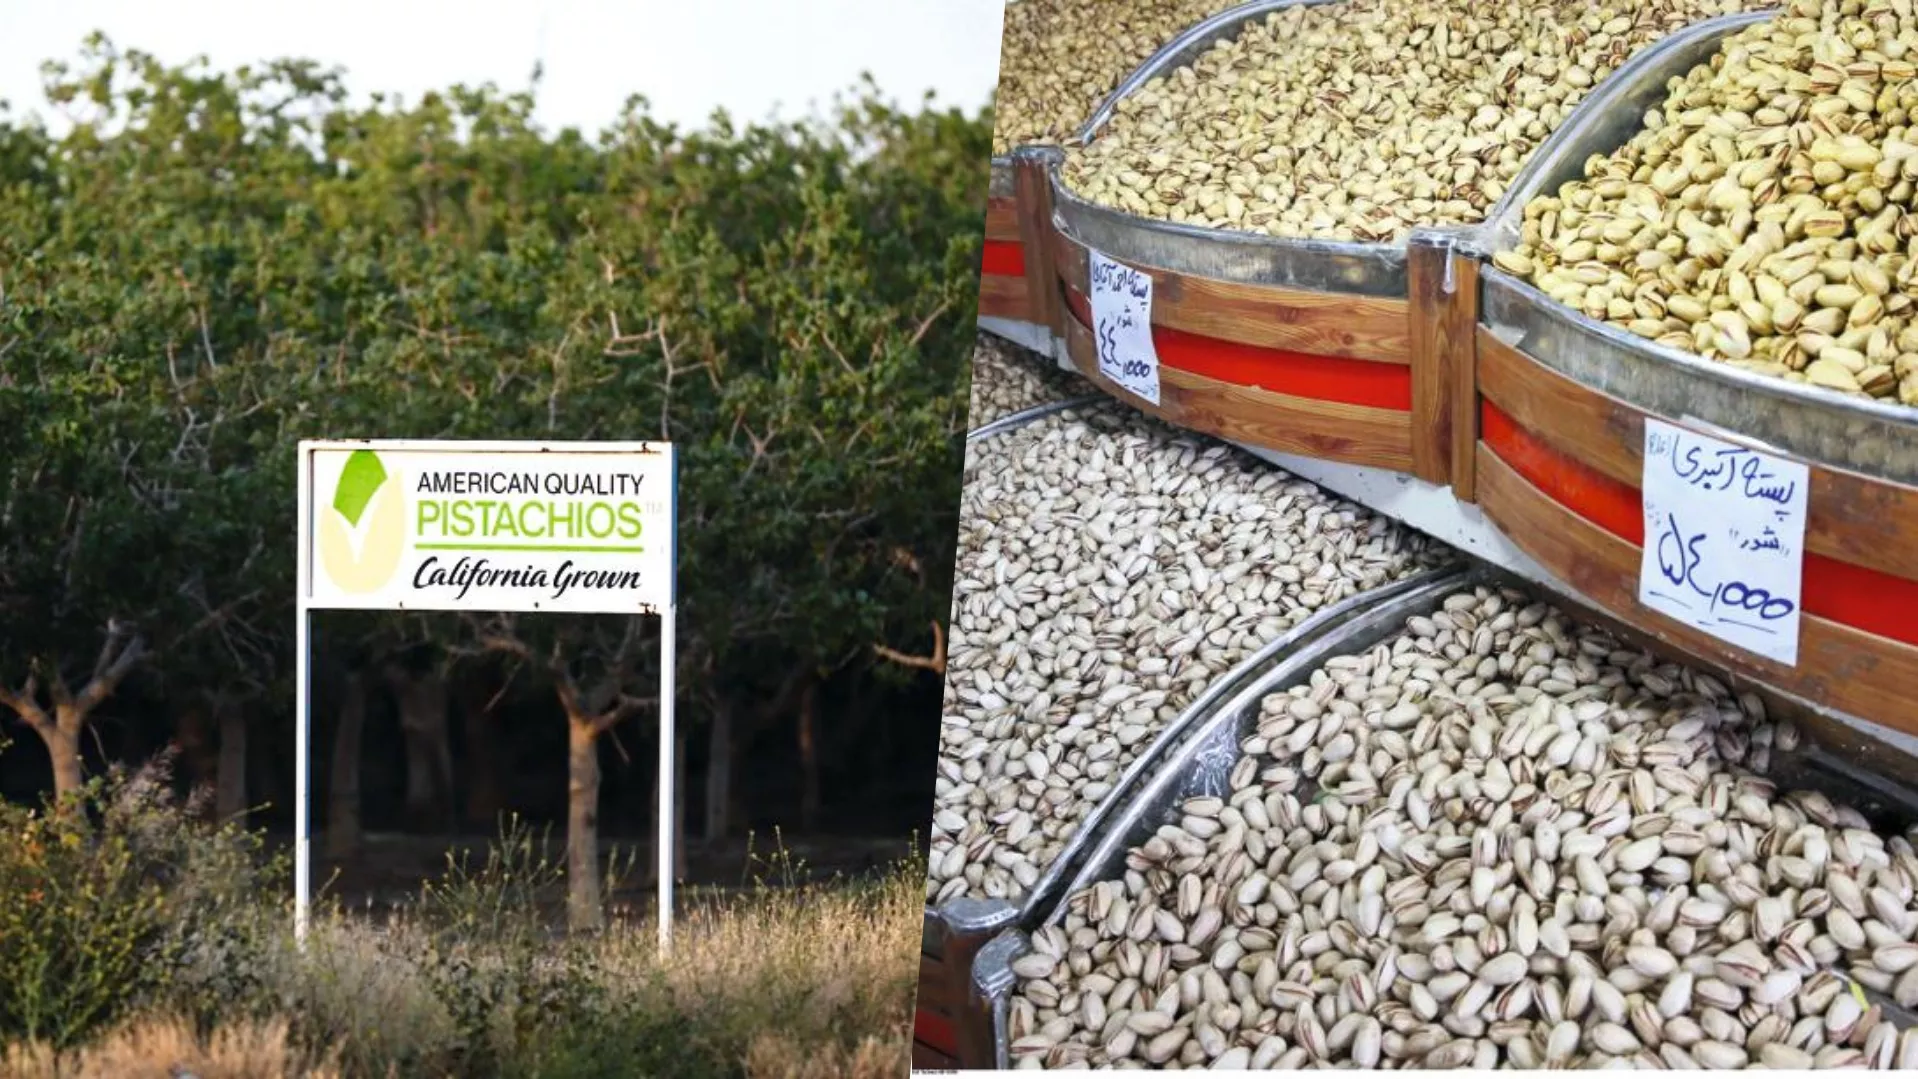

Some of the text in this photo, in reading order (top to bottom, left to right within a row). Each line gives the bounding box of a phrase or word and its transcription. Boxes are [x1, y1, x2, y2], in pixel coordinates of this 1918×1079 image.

[417, 472, 645, 497] AMERICAN QUALITY
[417, 500, 643, 539] PISTACHIOS
[413, 556, 641, 600] California Grown
